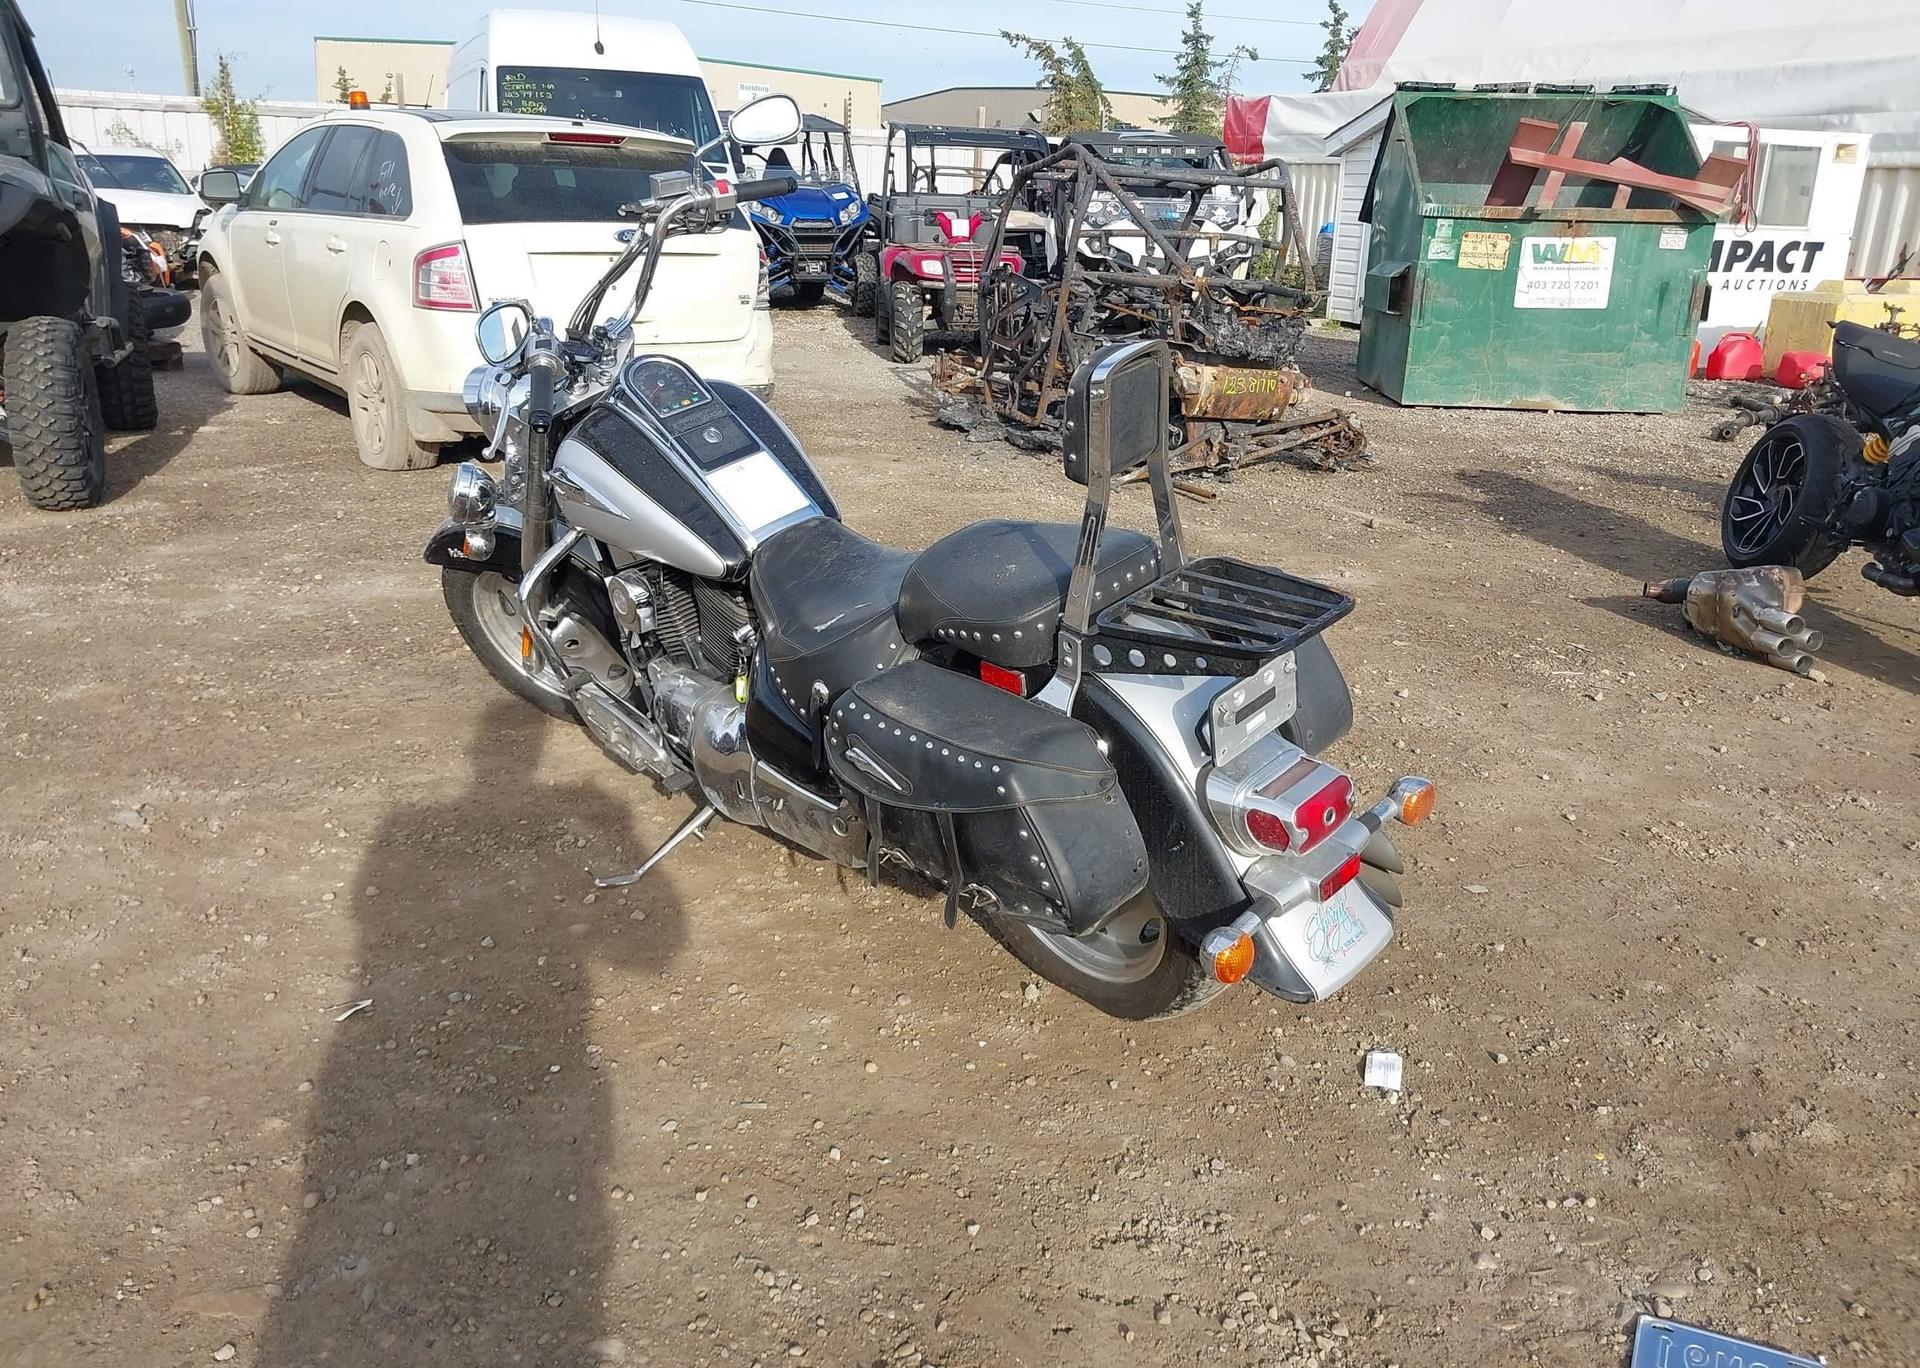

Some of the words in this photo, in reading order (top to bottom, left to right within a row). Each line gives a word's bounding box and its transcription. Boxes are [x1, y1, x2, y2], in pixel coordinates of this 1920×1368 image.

[1532, 243, 1600, 264] WM
[1708, 240, 1825, 273] PACT
[1527, 281, 1547, 290] 403
[1551, 281, 1571, 290] 720
[1574, 281, 1599, 290] 7201
[1721, 279, 1809, 291] AUCTIONS
